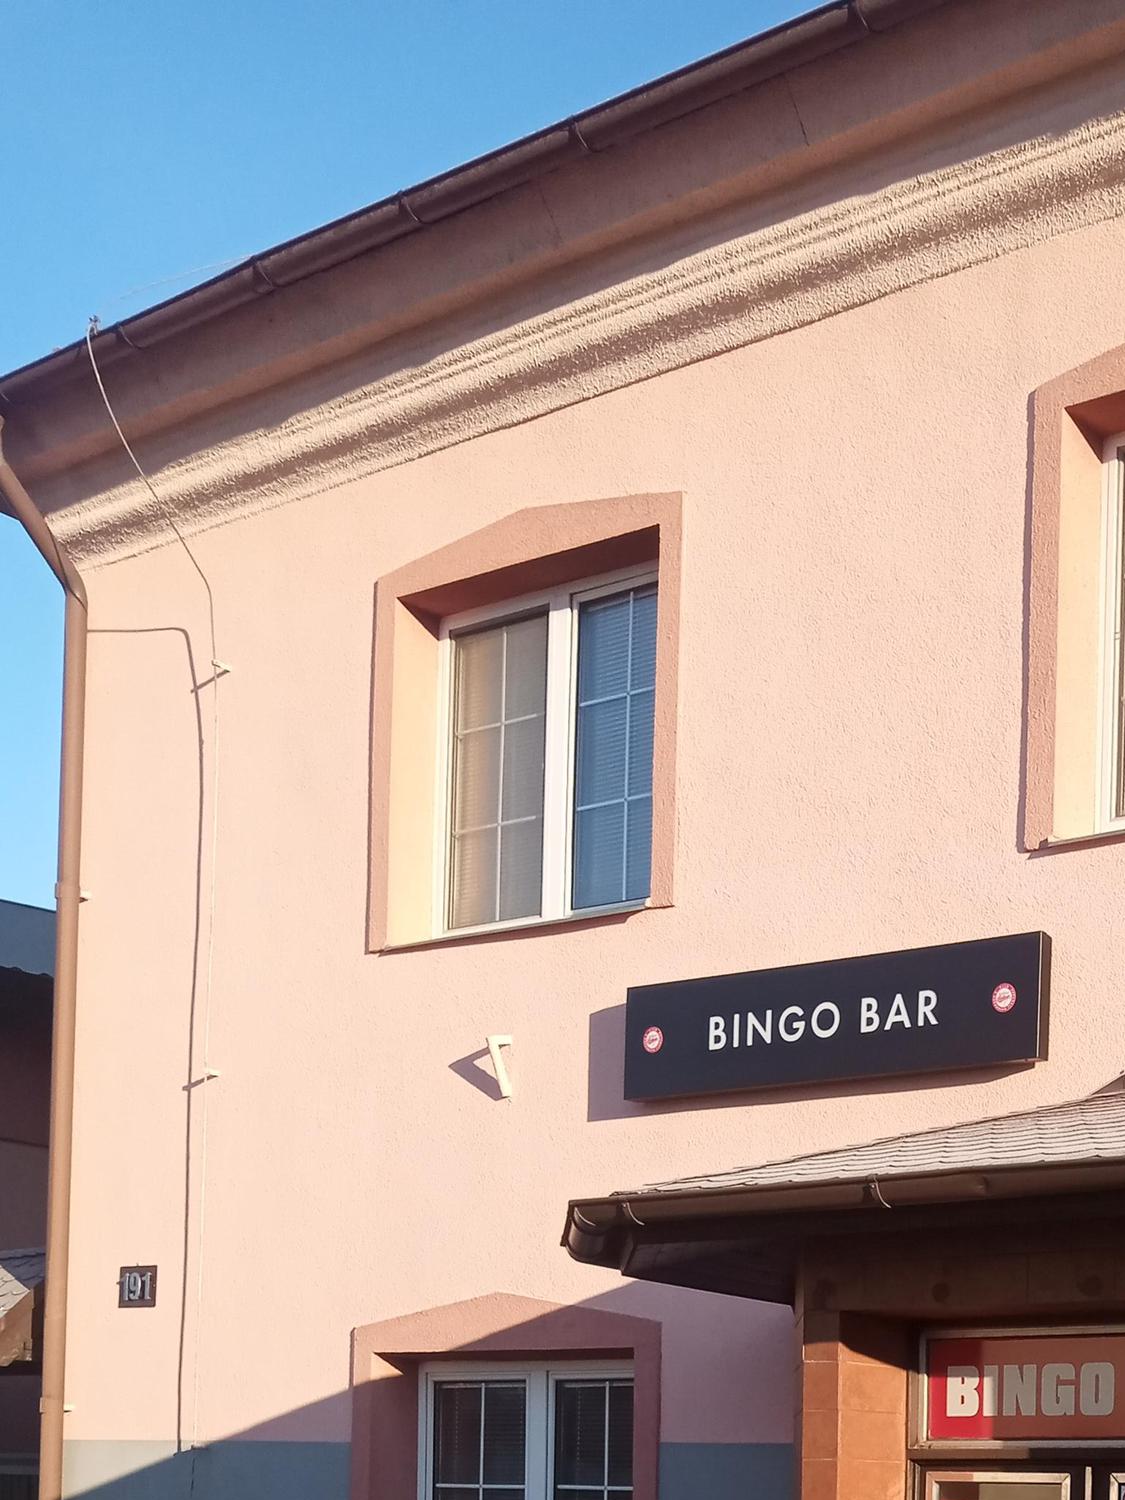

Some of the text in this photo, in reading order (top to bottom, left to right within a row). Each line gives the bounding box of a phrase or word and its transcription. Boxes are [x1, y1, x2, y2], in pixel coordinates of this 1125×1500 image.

[707, 1001, 841, 1051] BINGO
[859, 989, 939, 1034] BAR
[119, 1271, 153, 1301] 191
[946, 1361, 1115, 1417] BINGO
